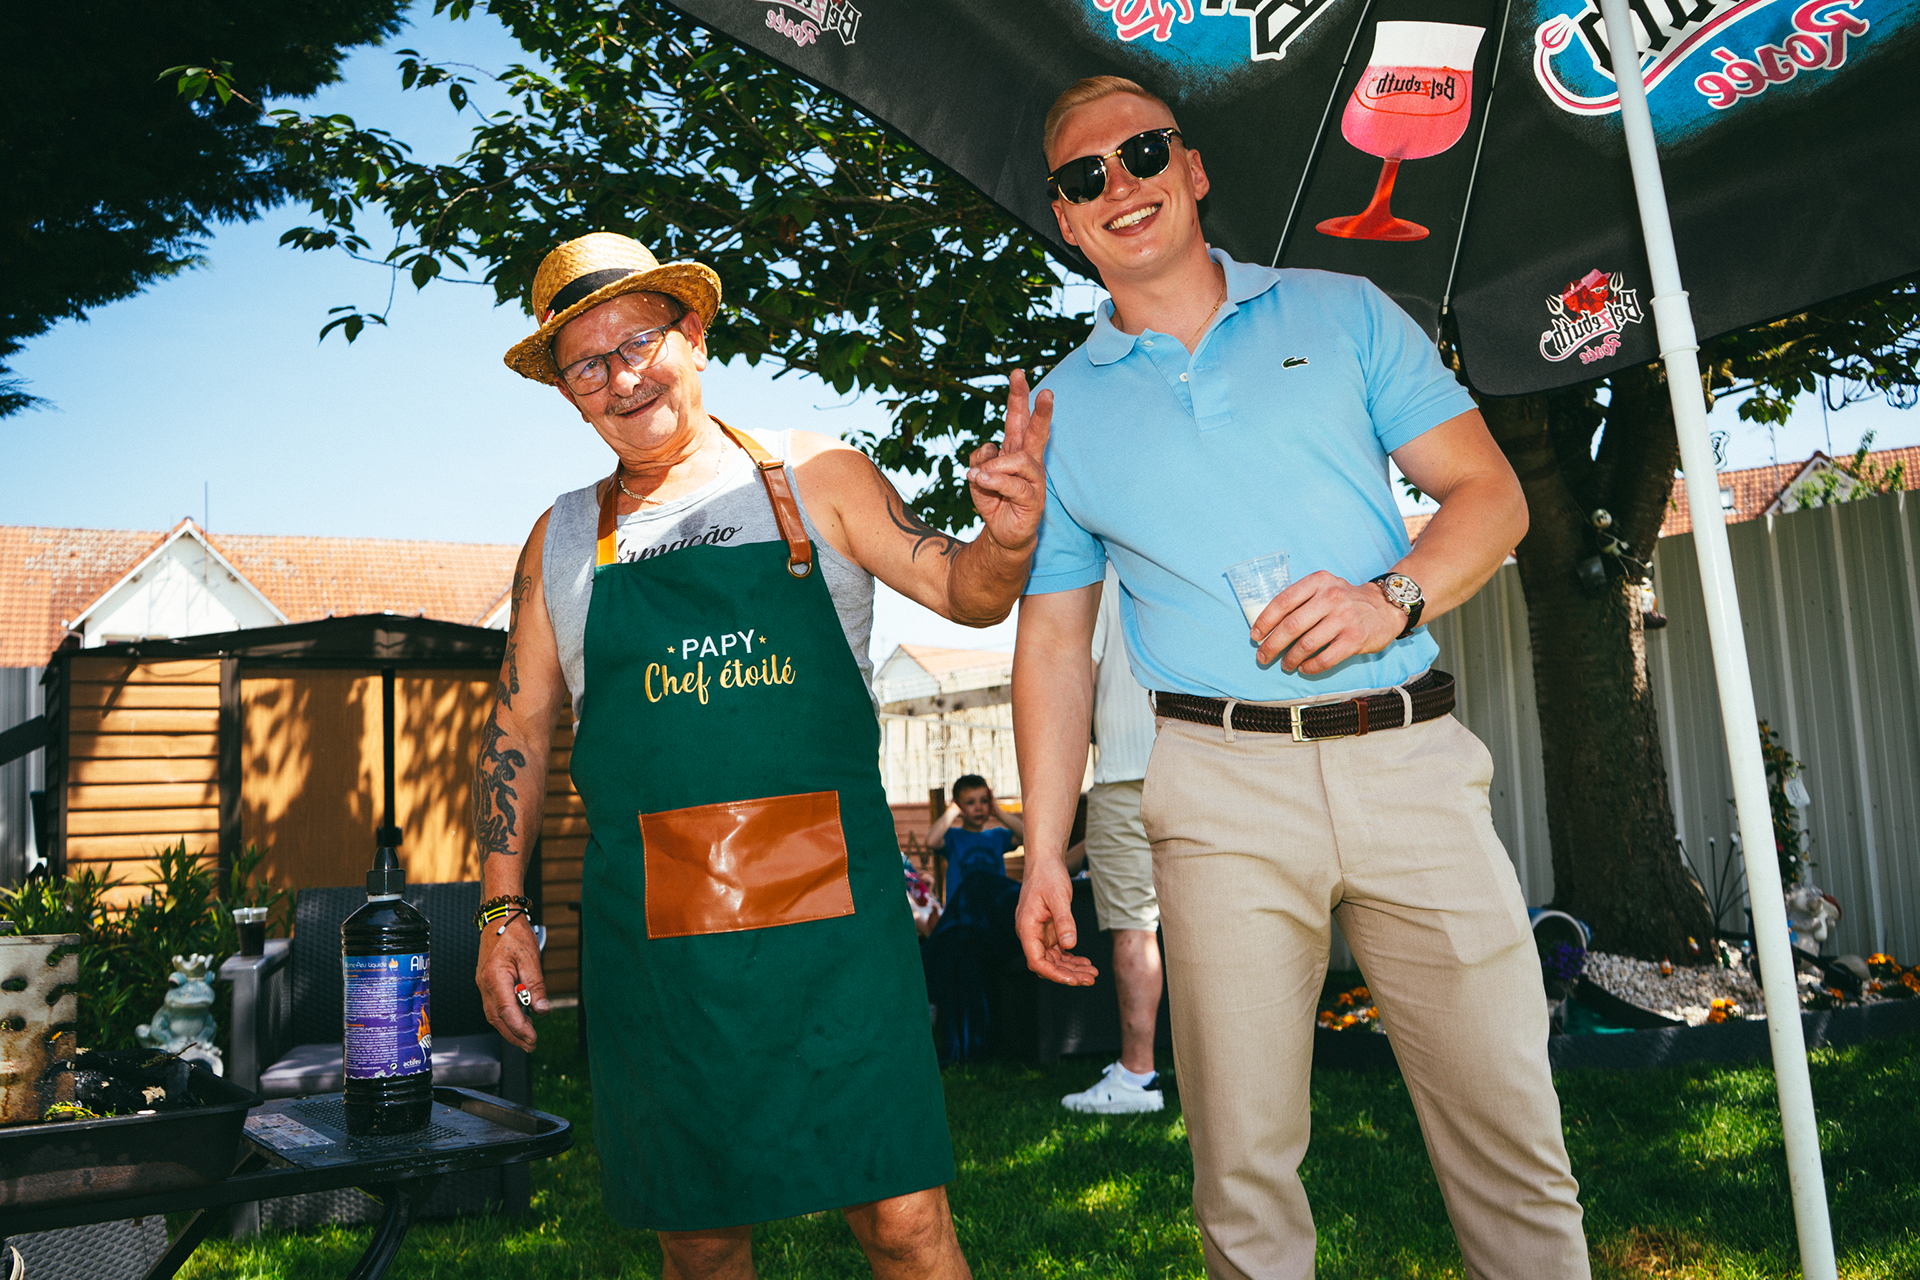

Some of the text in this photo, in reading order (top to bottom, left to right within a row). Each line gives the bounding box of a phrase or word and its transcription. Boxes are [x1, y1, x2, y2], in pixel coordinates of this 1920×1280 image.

[682, 629, 755, 660] PAPY
[645, 654, 796, 705] Chef étoilé
